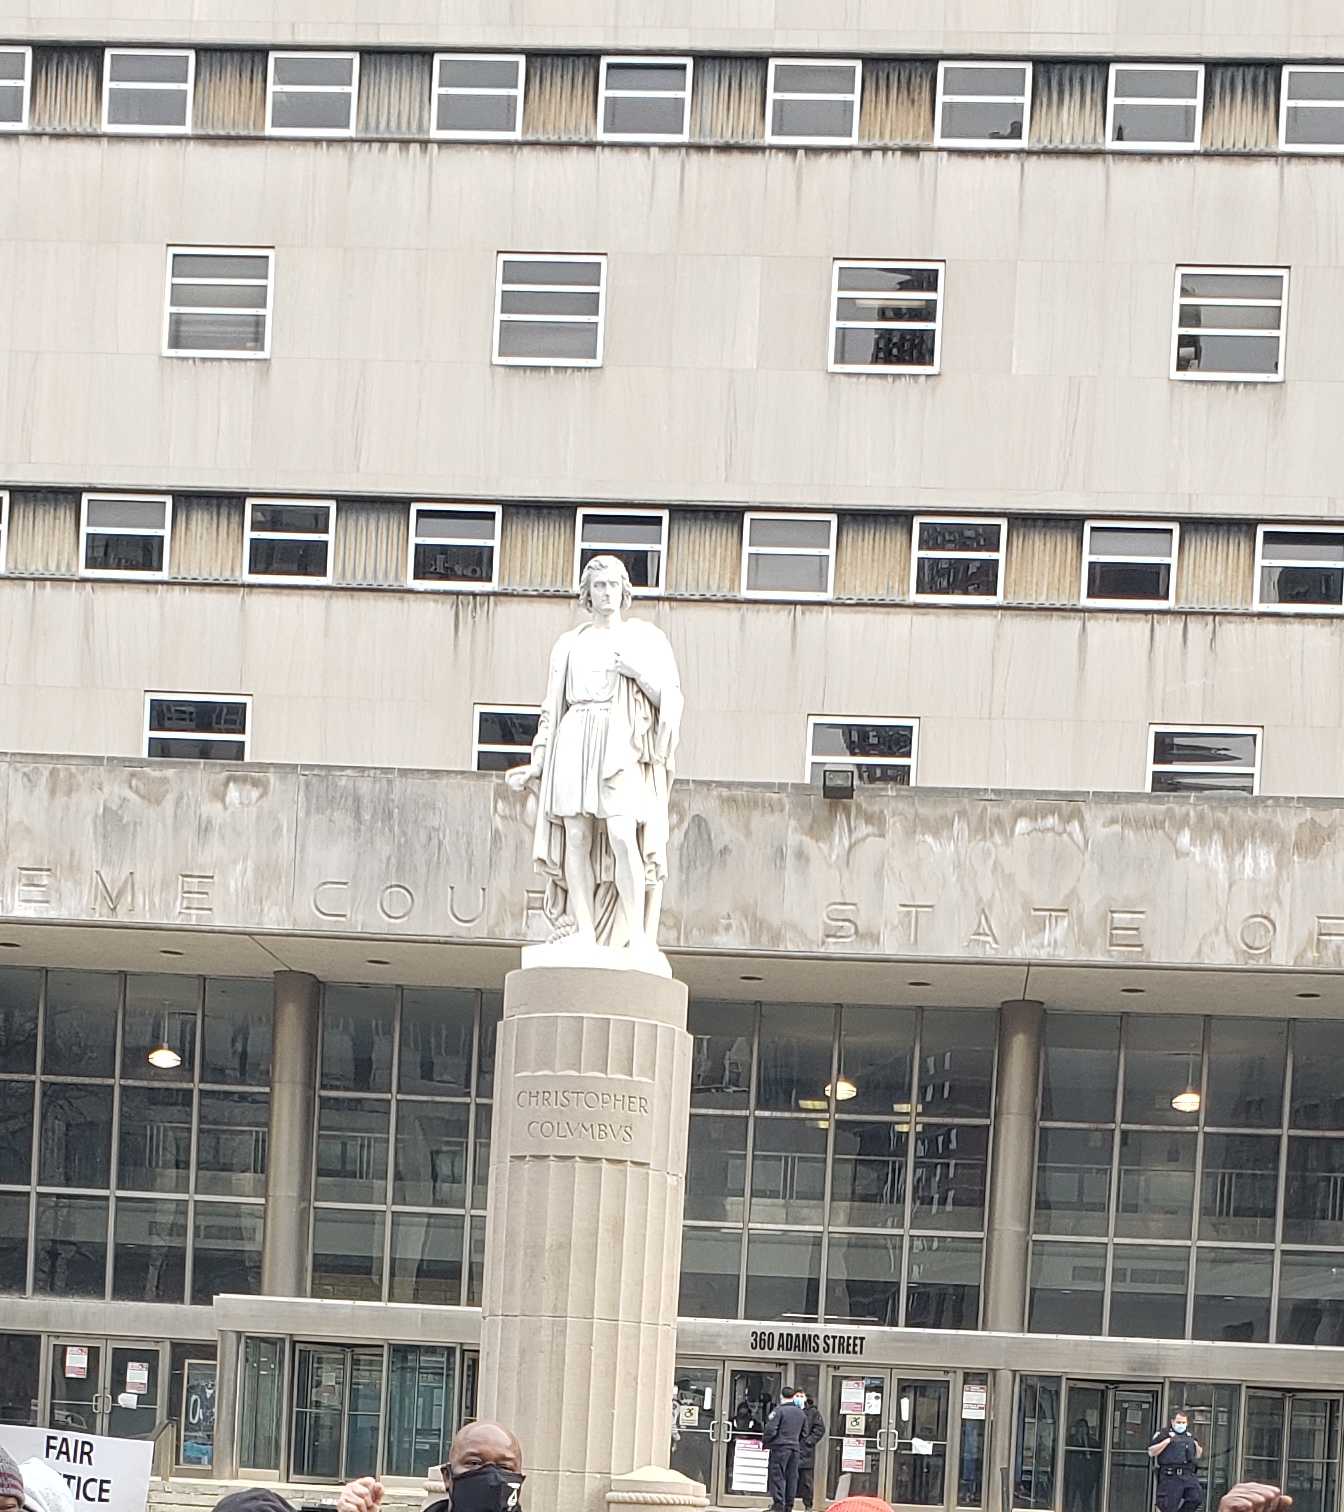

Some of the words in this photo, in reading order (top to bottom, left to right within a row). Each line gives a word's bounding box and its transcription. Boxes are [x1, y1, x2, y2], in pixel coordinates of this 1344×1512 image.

[311, 880, 556, 930] COUR
[823, 901, 1146, 951] STATE
[517, 1090, 649, 1114] CHRISTOPHER
[750, 1331, 775, 1351] 360
[777, 1332, 820, 1353] ADAMS
[823, 1334, 866, 1355] STREET
[44, 1435, 94, 1466] FAIR
[60, 1472, 112, 1503] TICE
